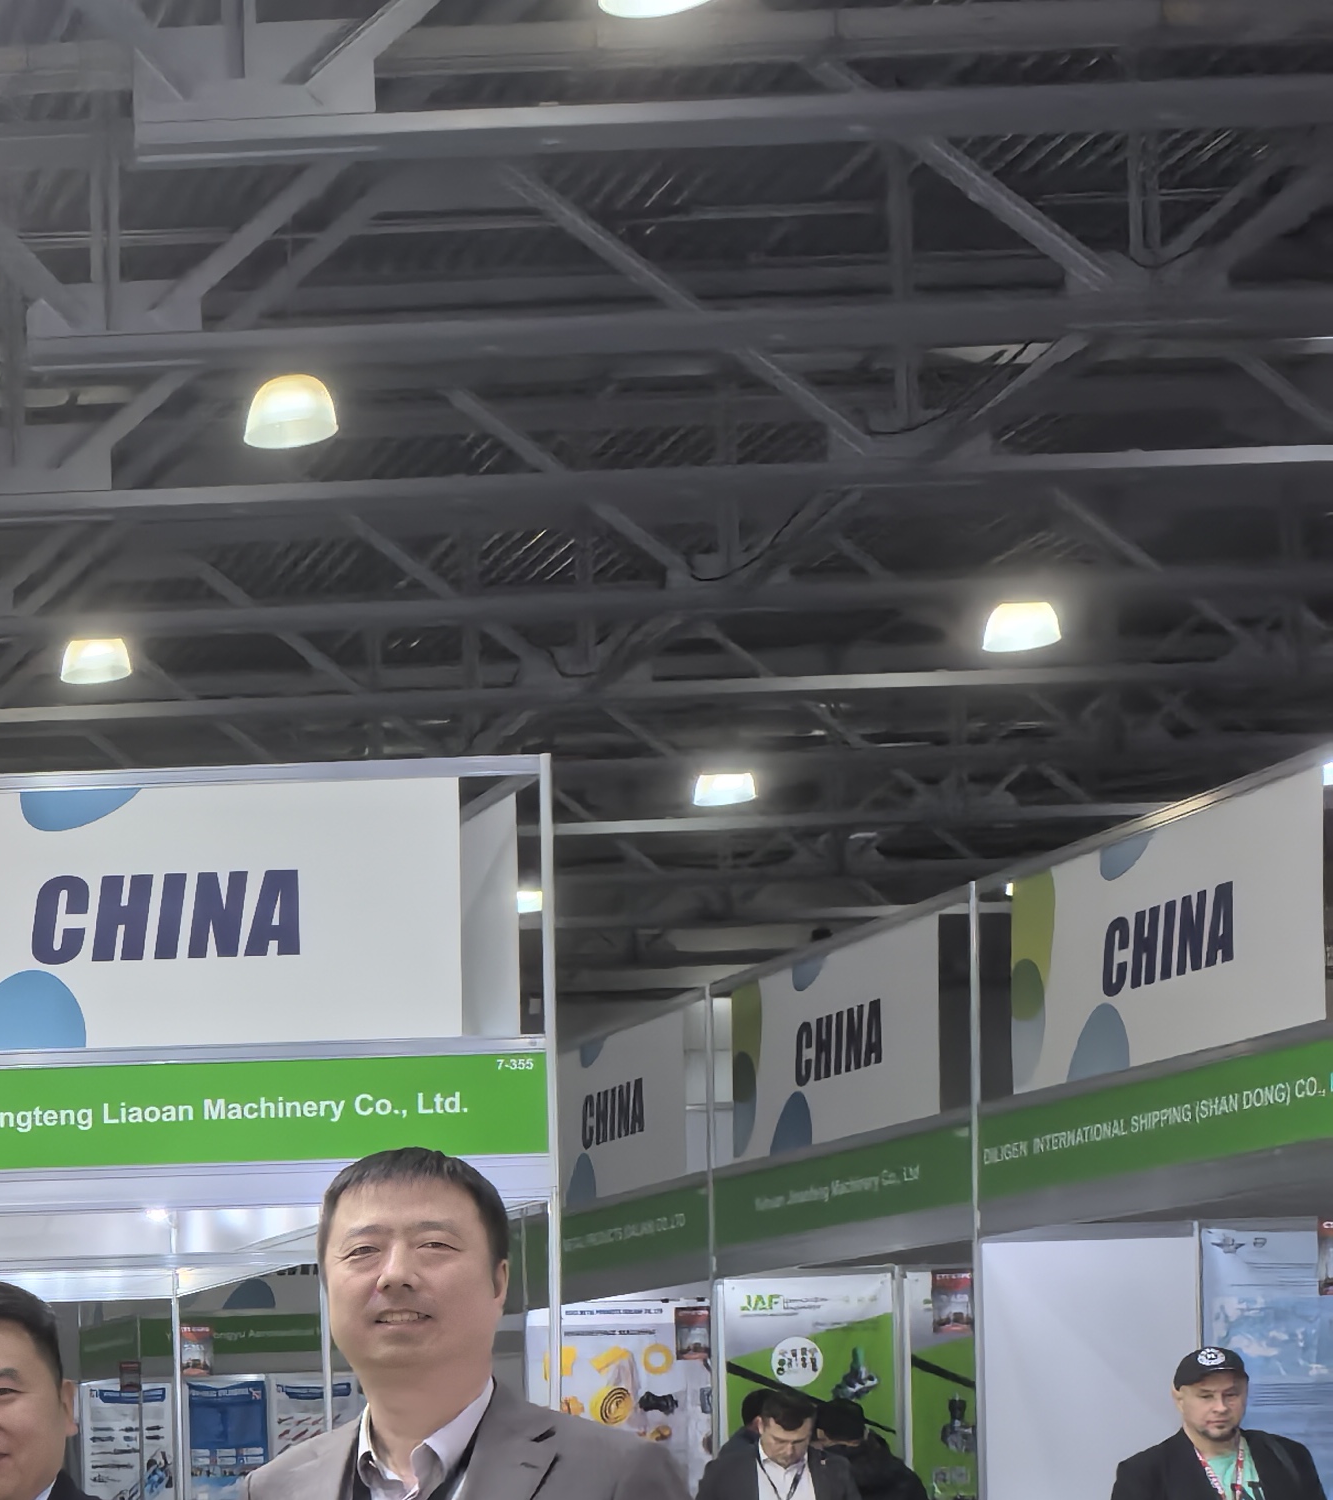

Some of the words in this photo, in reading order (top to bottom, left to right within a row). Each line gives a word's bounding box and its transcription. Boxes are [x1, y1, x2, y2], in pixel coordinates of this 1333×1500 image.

[32, 870, 301, 965] CHINA
[1102, 880, 1234, 997] CHINA
[496, 1059, 534, 1071] 7-355
[794, 998, 882, 1087] CHINA
[103, 1102, 194, 1124] Liaoan
[204, 1096, 345, 1122] Machinery
[355, 1093, 407, 1118] Co.,
[418, 1091, 468, 1115] Ltd.
[582, 1077, 645, 1150] CHINA
[1033, 1118, 1128, 1154] INTERNATIONAL
[1130, 1103, 1192, 1133] SHIPPING
[1242, 1082, 1290, 1111] DONG)
